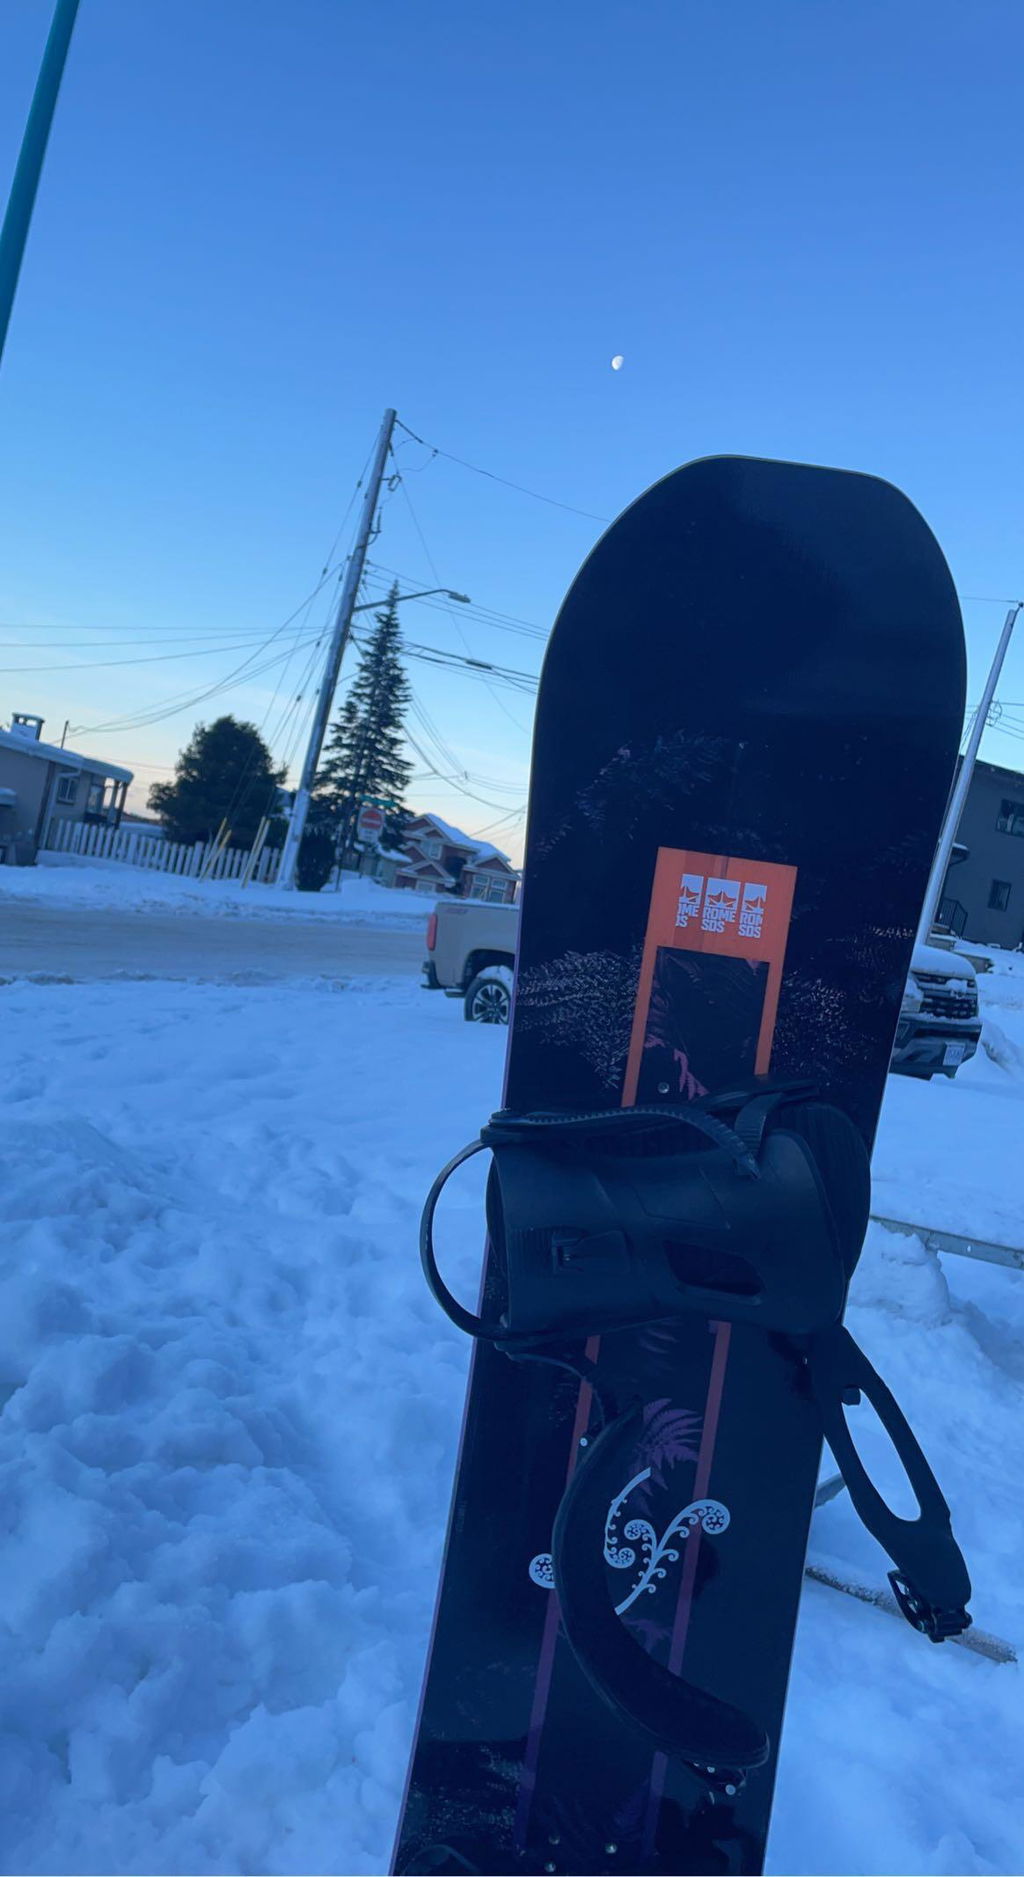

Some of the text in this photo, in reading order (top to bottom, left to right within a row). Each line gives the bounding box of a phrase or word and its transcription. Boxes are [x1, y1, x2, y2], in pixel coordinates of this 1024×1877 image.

[702, 906, 736, 922] ROME
[701, 919, 725, 933] SDS
[738, 924, 761, 938] SDS
